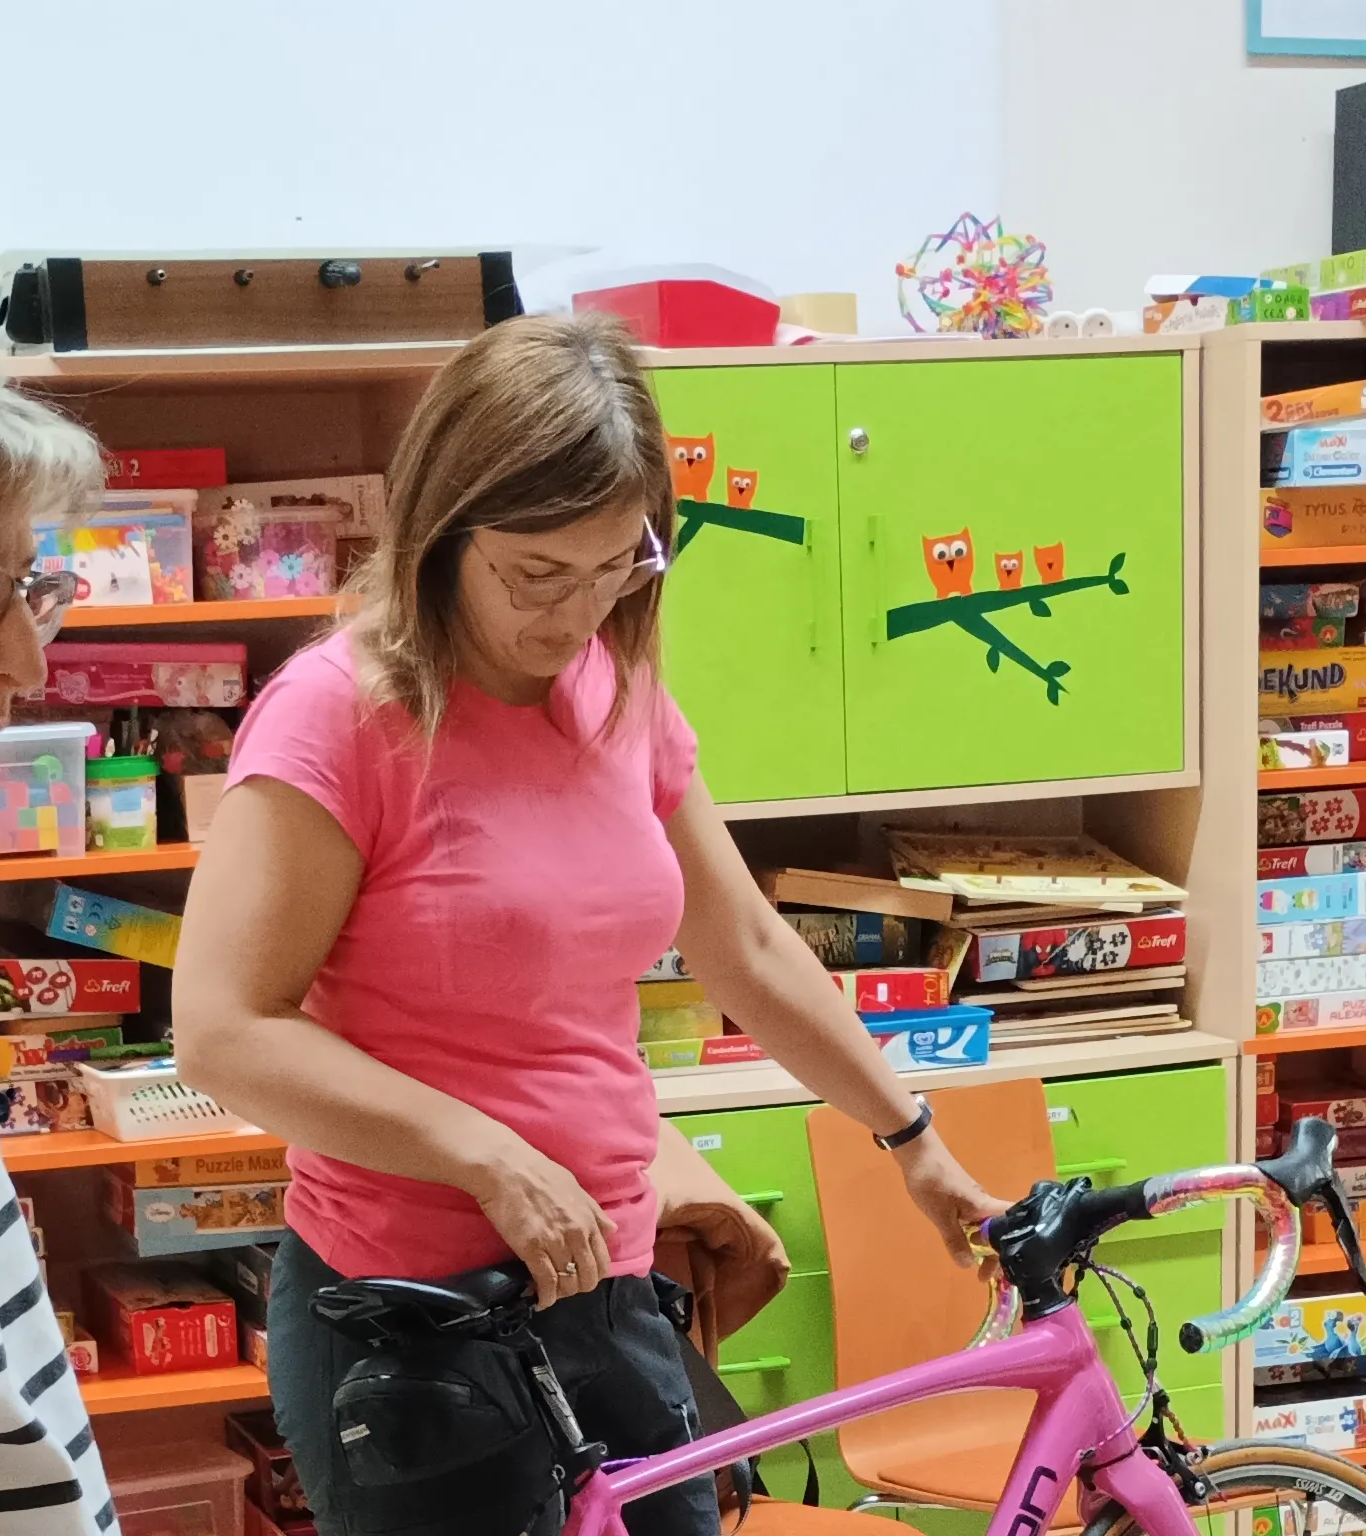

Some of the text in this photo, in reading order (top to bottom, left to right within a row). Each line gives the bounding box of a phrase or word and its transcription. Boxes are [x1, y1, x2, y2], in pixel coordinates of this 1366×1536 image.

[1304, 502, 1347, 517] TYTUS
[1258, 663, 1347, 703] EKUND
[1270, 856, 1298, 872] Trefl
[1151, 934, 1178, 948] Trefl
[100, 979, 132, 994] Trefl
[696, 1138, 715, 1149] GRY
[195, 1155, 283, 1174] Puzzle Maxi
[1293, 1478, 1346, 1503] DT SWISS
